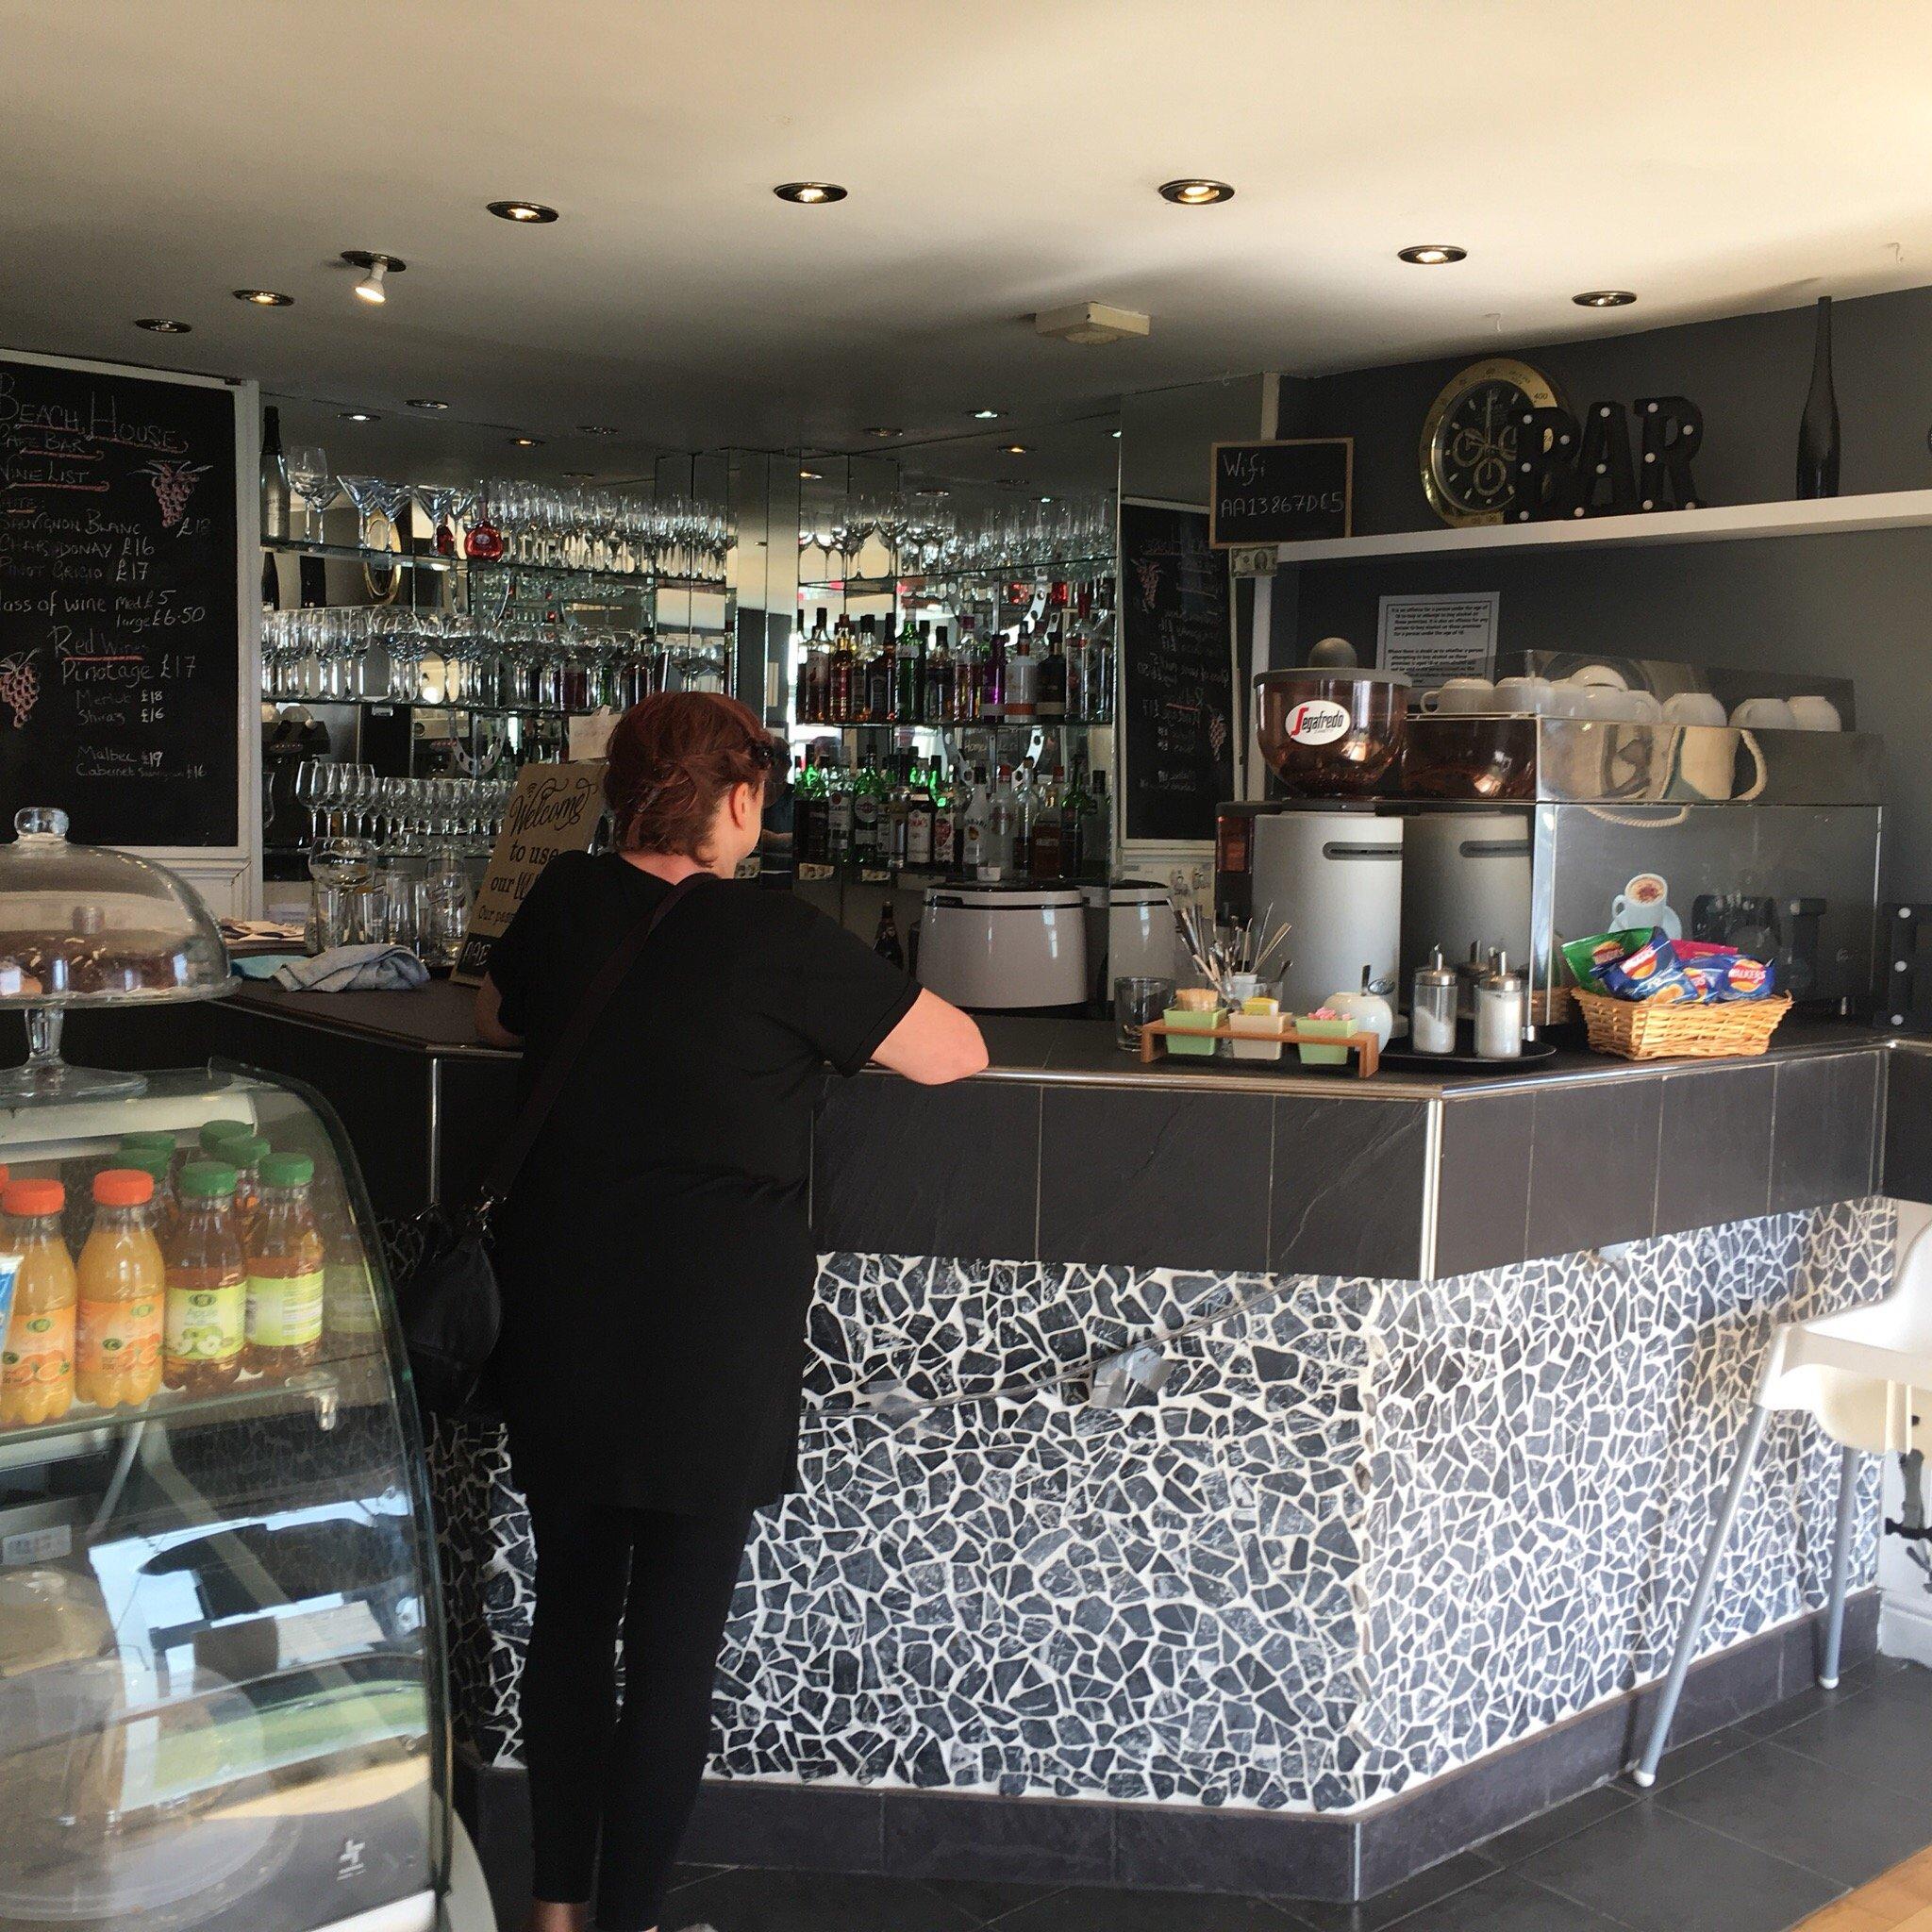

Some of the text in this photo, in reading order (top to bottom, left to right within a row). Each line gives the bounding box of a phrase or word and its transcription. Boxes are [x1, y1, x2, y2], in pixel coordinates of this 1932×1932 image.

[90, 391, 178, 449] HOUSE
[48, 461, 90, 483] LIST
[1223, 451, 1267, 487] Wifi
[1505, 395, 1708, 525] BAR
[85, 508, 142, 536] BLANC
[122, 536, 155, 557] £16
[115, 558, 149, 582] £17
[37, 590, 58, 617] of
[64, 596, 108, 613] wine
[47, 625, 94, 658] Red
[60, 654, 197, 689] Pinotage £17
[141, 690, 164, 704] £18
[140, 708, 166, 724] £16
[1291, 706, 1344, 736] Segafredo
[509, 778, 598, 838] Welcome
[509, 840, 559, 866] to use
[490, 876, 515, 893] our
